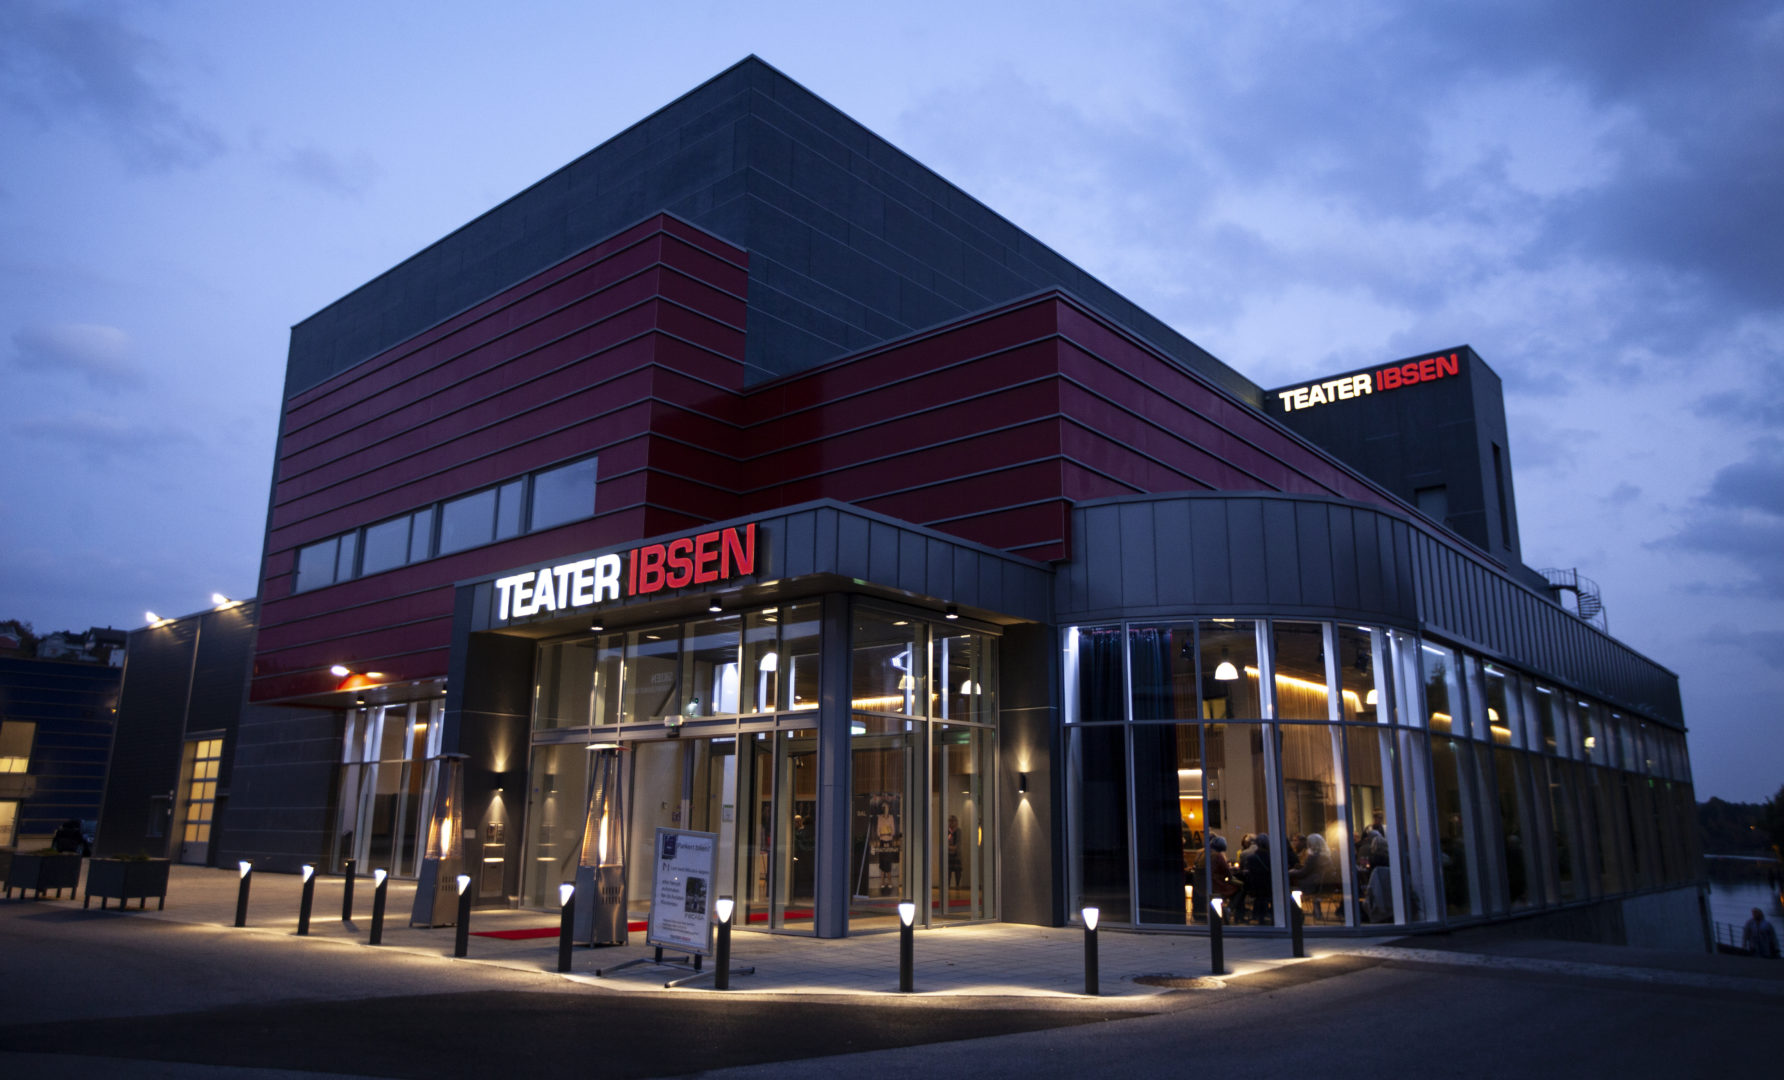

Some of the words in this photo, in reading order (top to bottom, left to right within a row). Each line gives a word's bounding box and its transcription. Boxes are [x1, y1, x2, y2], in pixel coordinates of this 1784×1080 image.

[1279, 374, 1372, 412] TEATER
[1376, 353, 1459, 391] IBSEN
[496, 554, 621, 620] TEATER
[628, 523, 755, 596] IBSEN
